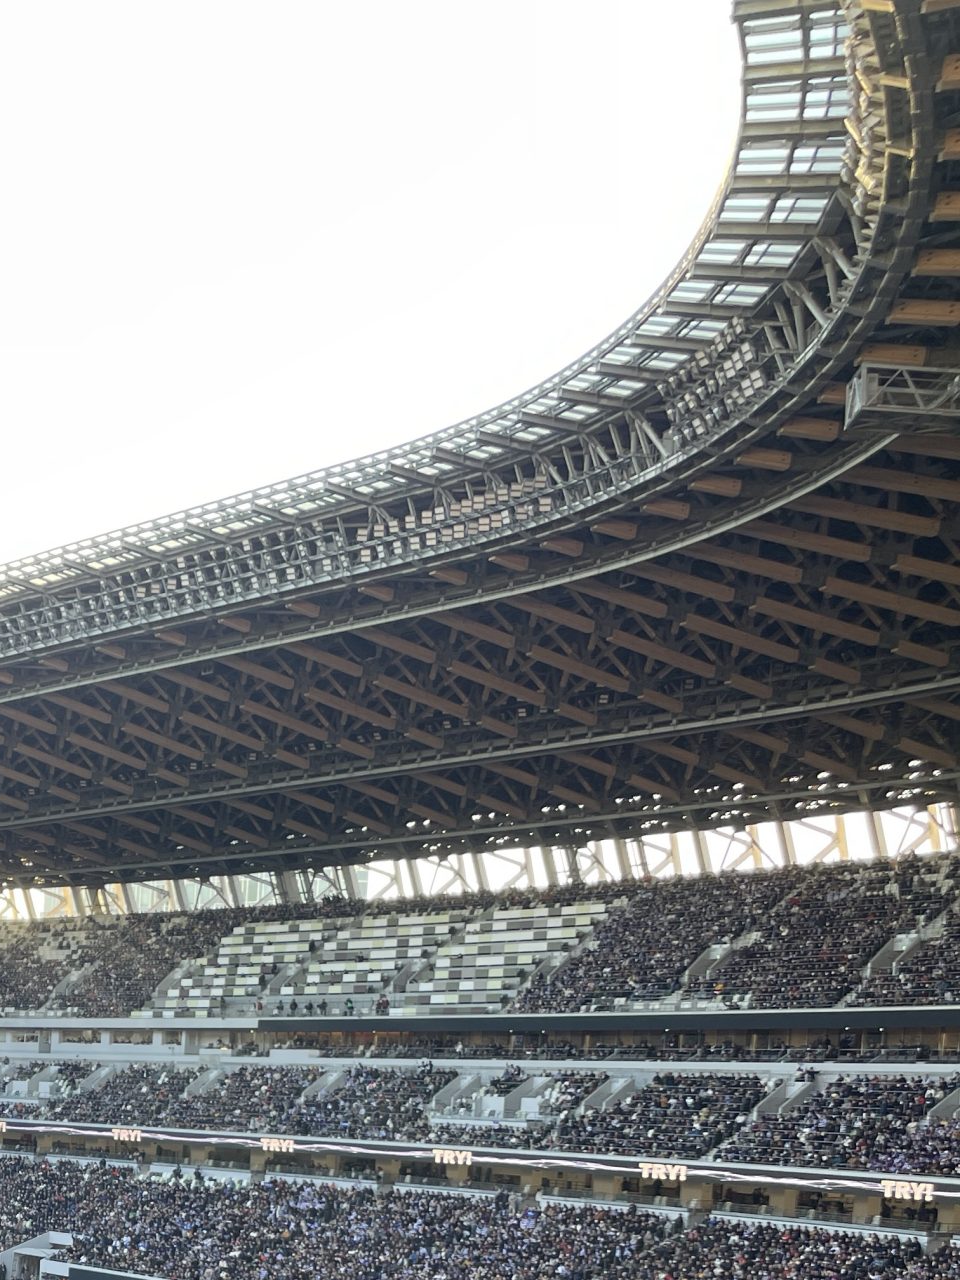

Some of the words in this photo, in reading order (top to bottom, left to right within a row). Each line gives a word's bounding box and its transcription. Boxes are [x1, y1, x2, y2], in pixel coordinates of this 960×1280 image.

[112, 1128, 142, 1142] TRY!
[260, 1138, 294, 1152] TRY!
[432, 1149, 472, 1165] TRY!
[639, 1162, 687, 1181] TRY!
[881, 1180, 934, 1201] TRY!
